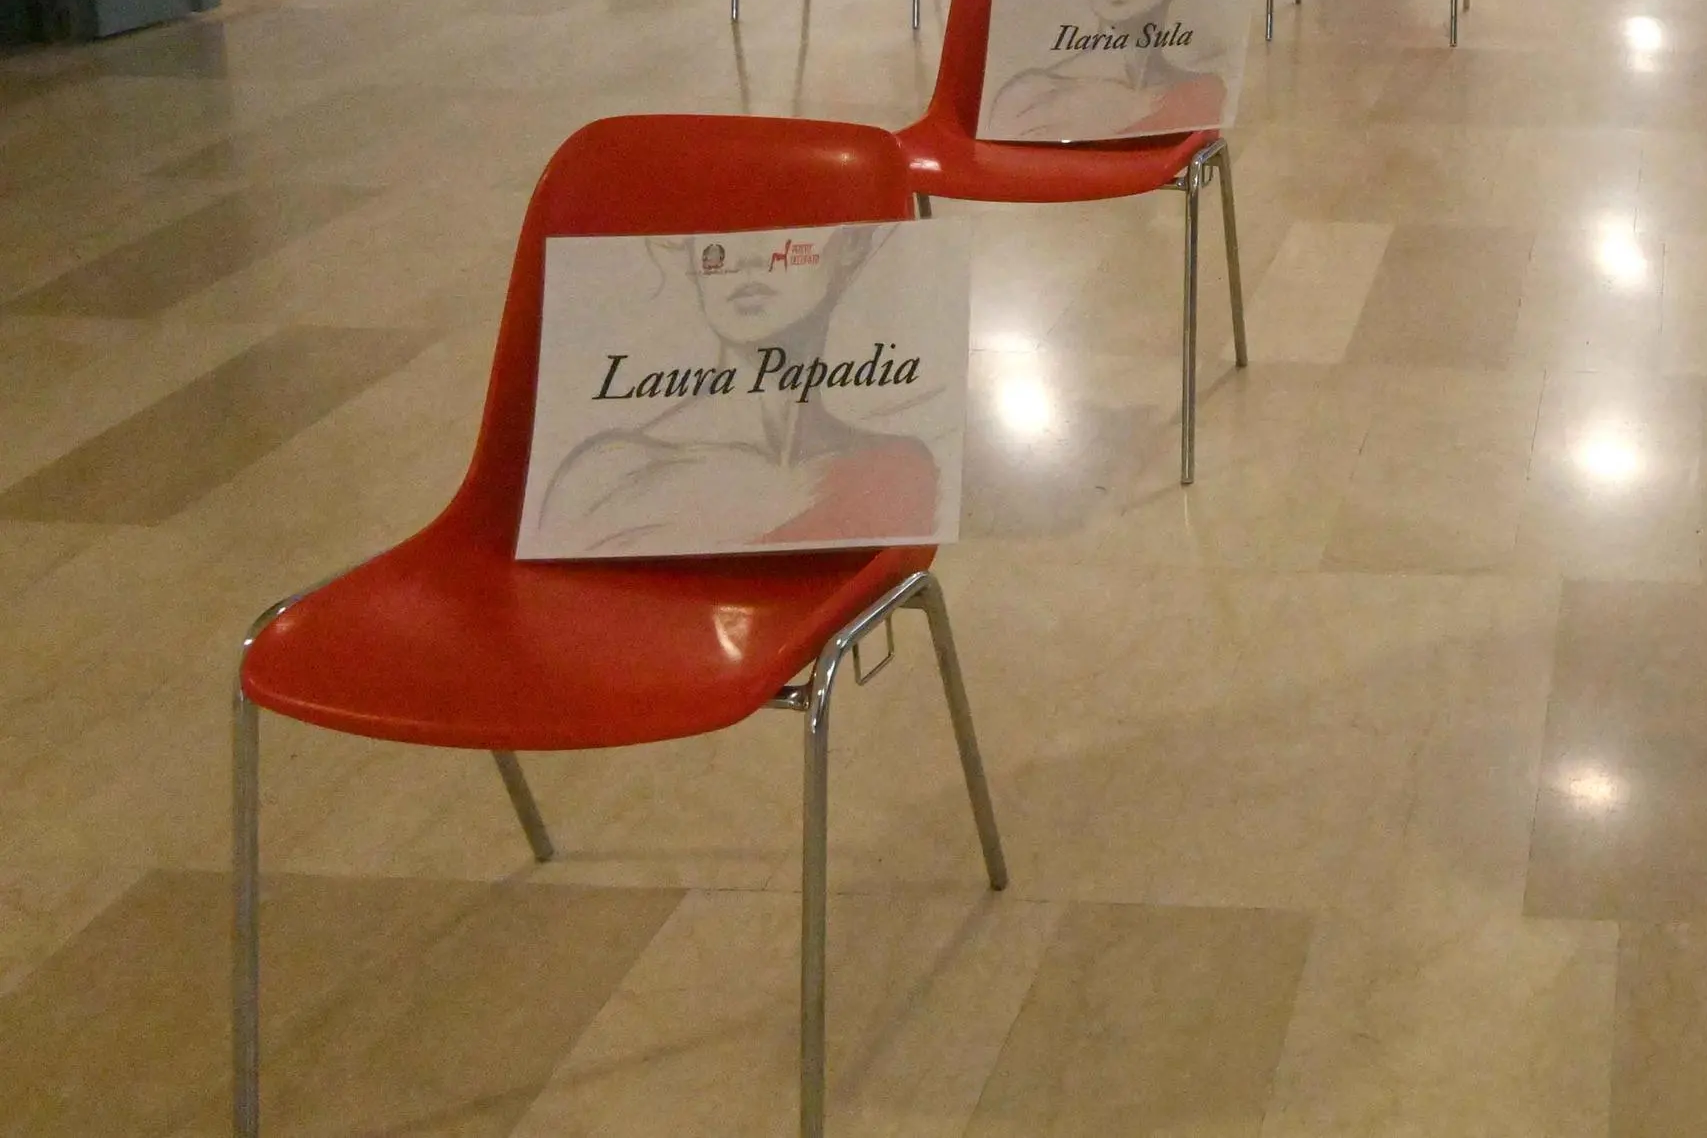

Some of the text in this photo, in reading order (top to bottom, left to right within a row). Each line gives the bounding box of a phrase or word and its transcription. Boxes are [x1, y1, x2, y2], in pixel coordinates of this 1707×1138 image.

[1050, 21, 1195, 51] Ilaria Sula
[591, 342, 921, 404] Laura Papadia
